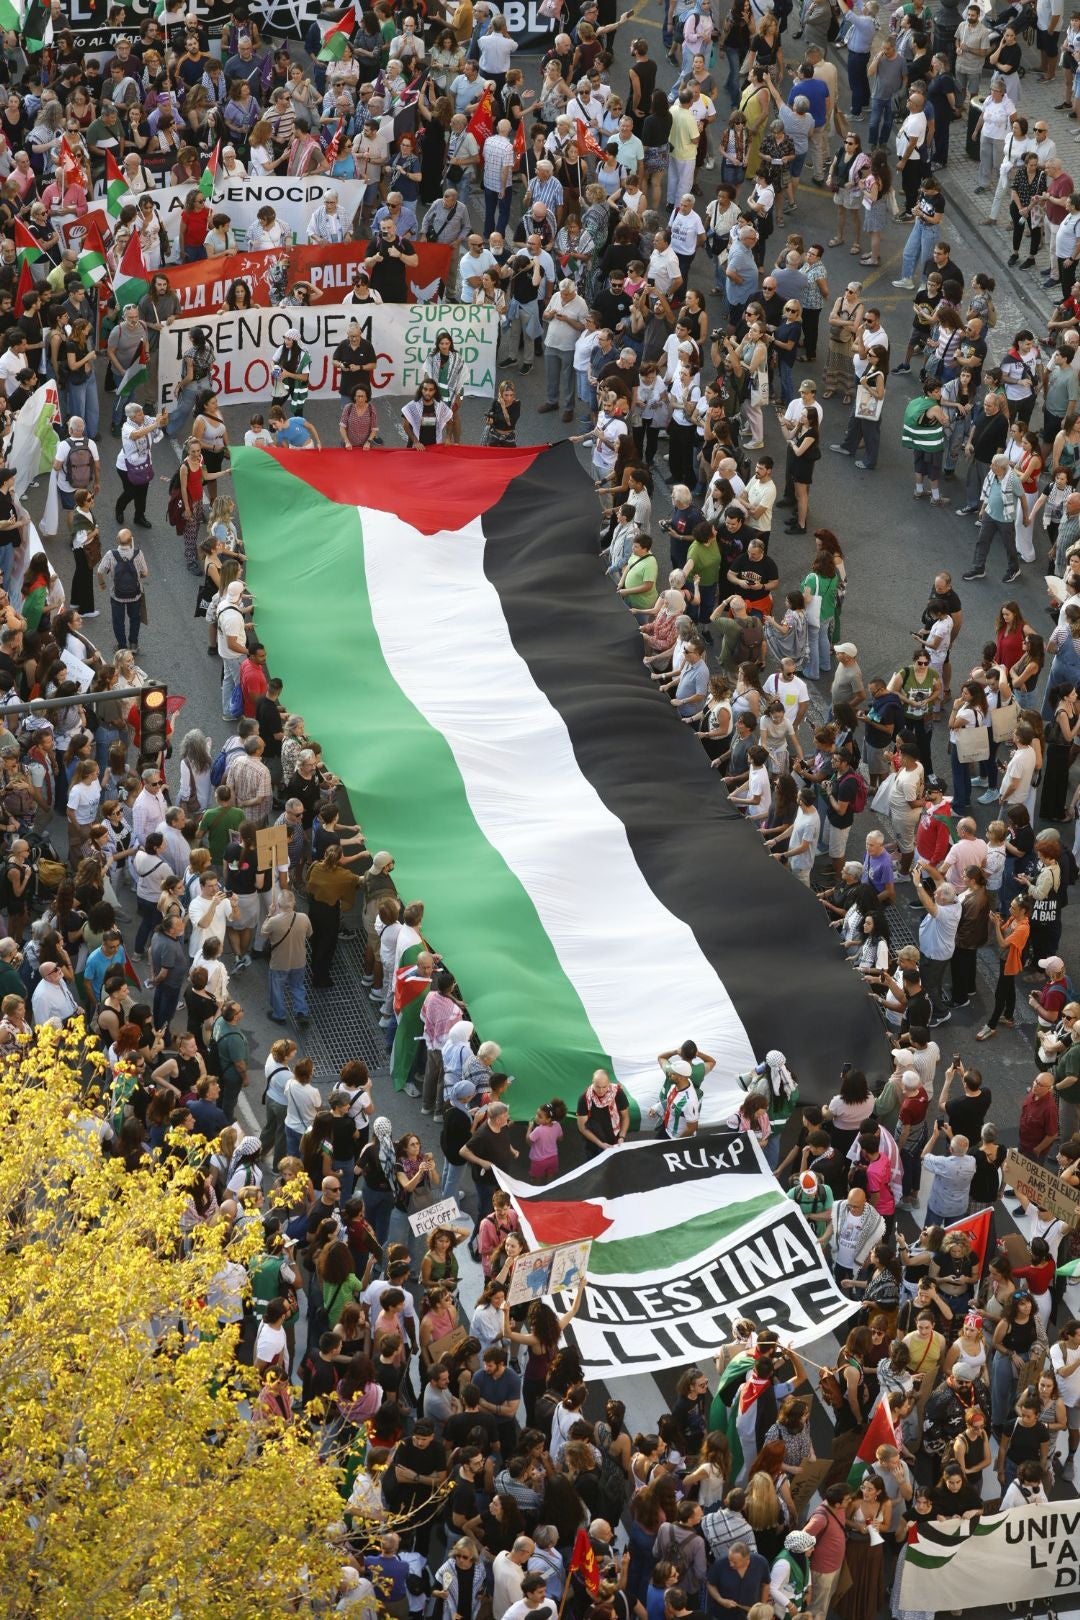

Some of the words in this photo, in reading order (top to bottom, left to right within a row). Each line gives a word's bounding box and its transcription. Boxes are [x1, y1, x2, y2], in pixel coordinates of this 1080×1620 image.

[89, 37, 106, 47] AL
[211, 185, 332, 205] GENOCID
[408, 305, 496, 324] SUPORT
[404, 347, 479, 364] SUD
[209, 352, 395, 396] BLOUEG
[1031, 909, 1038, 920] A
[1039, 910, 1056, 921] BAG
[1033, 900, 1048, 910] ART
[1049, 900, 1057, 910] IN
[662, 1137, 745, 1174] RUxP
[1020, 1159, 1046, 1182] POBLE
[1027, 1175, 1046, 1194] AMB
[1047, 1187, 1057, 1202] EL
[560, 1223, 819, 1322] PALESTINA
[561, 1278, 849, 1367] LLIURE
